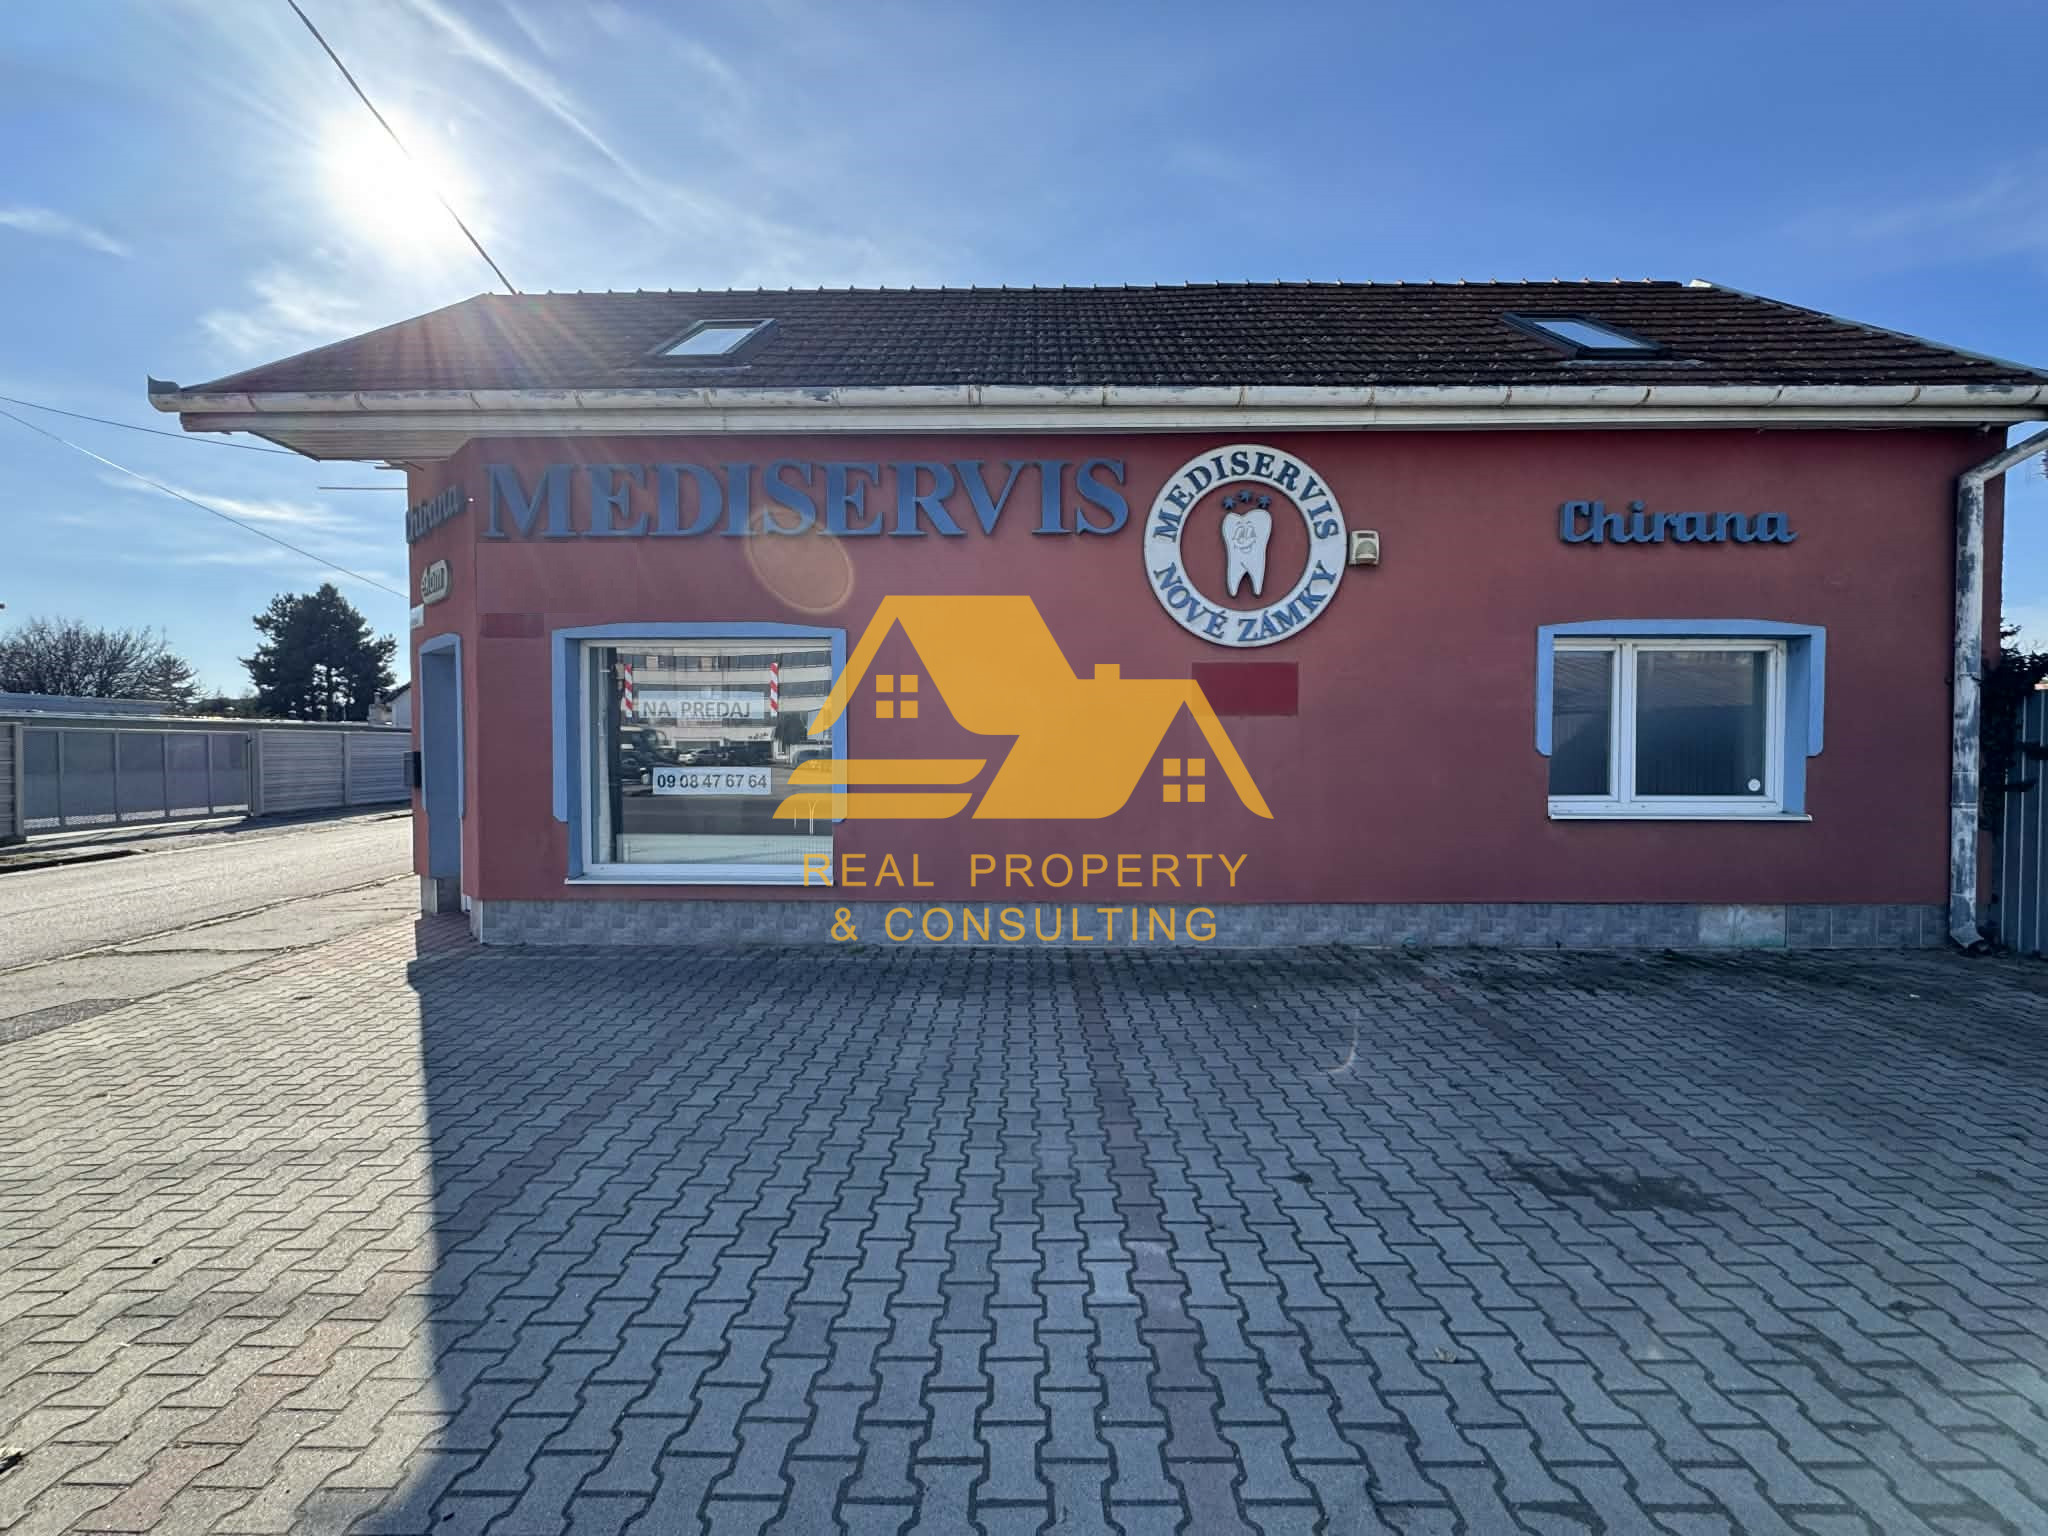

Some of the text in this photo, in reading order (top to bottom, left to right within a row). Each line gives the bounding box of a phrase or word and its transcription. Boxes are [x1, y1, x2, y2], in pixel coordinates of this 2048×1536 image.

[483, 459, 1129, 537] MEDISERVIS
[1152, 451, 1339, 543] MEDISERVIS
[1558, 500, 1799, 543] Chirana
[1153, 560, 1337, 642] NOVÉ ZÁMKY
[644, 702, 750, 718] NA PREDAJ
